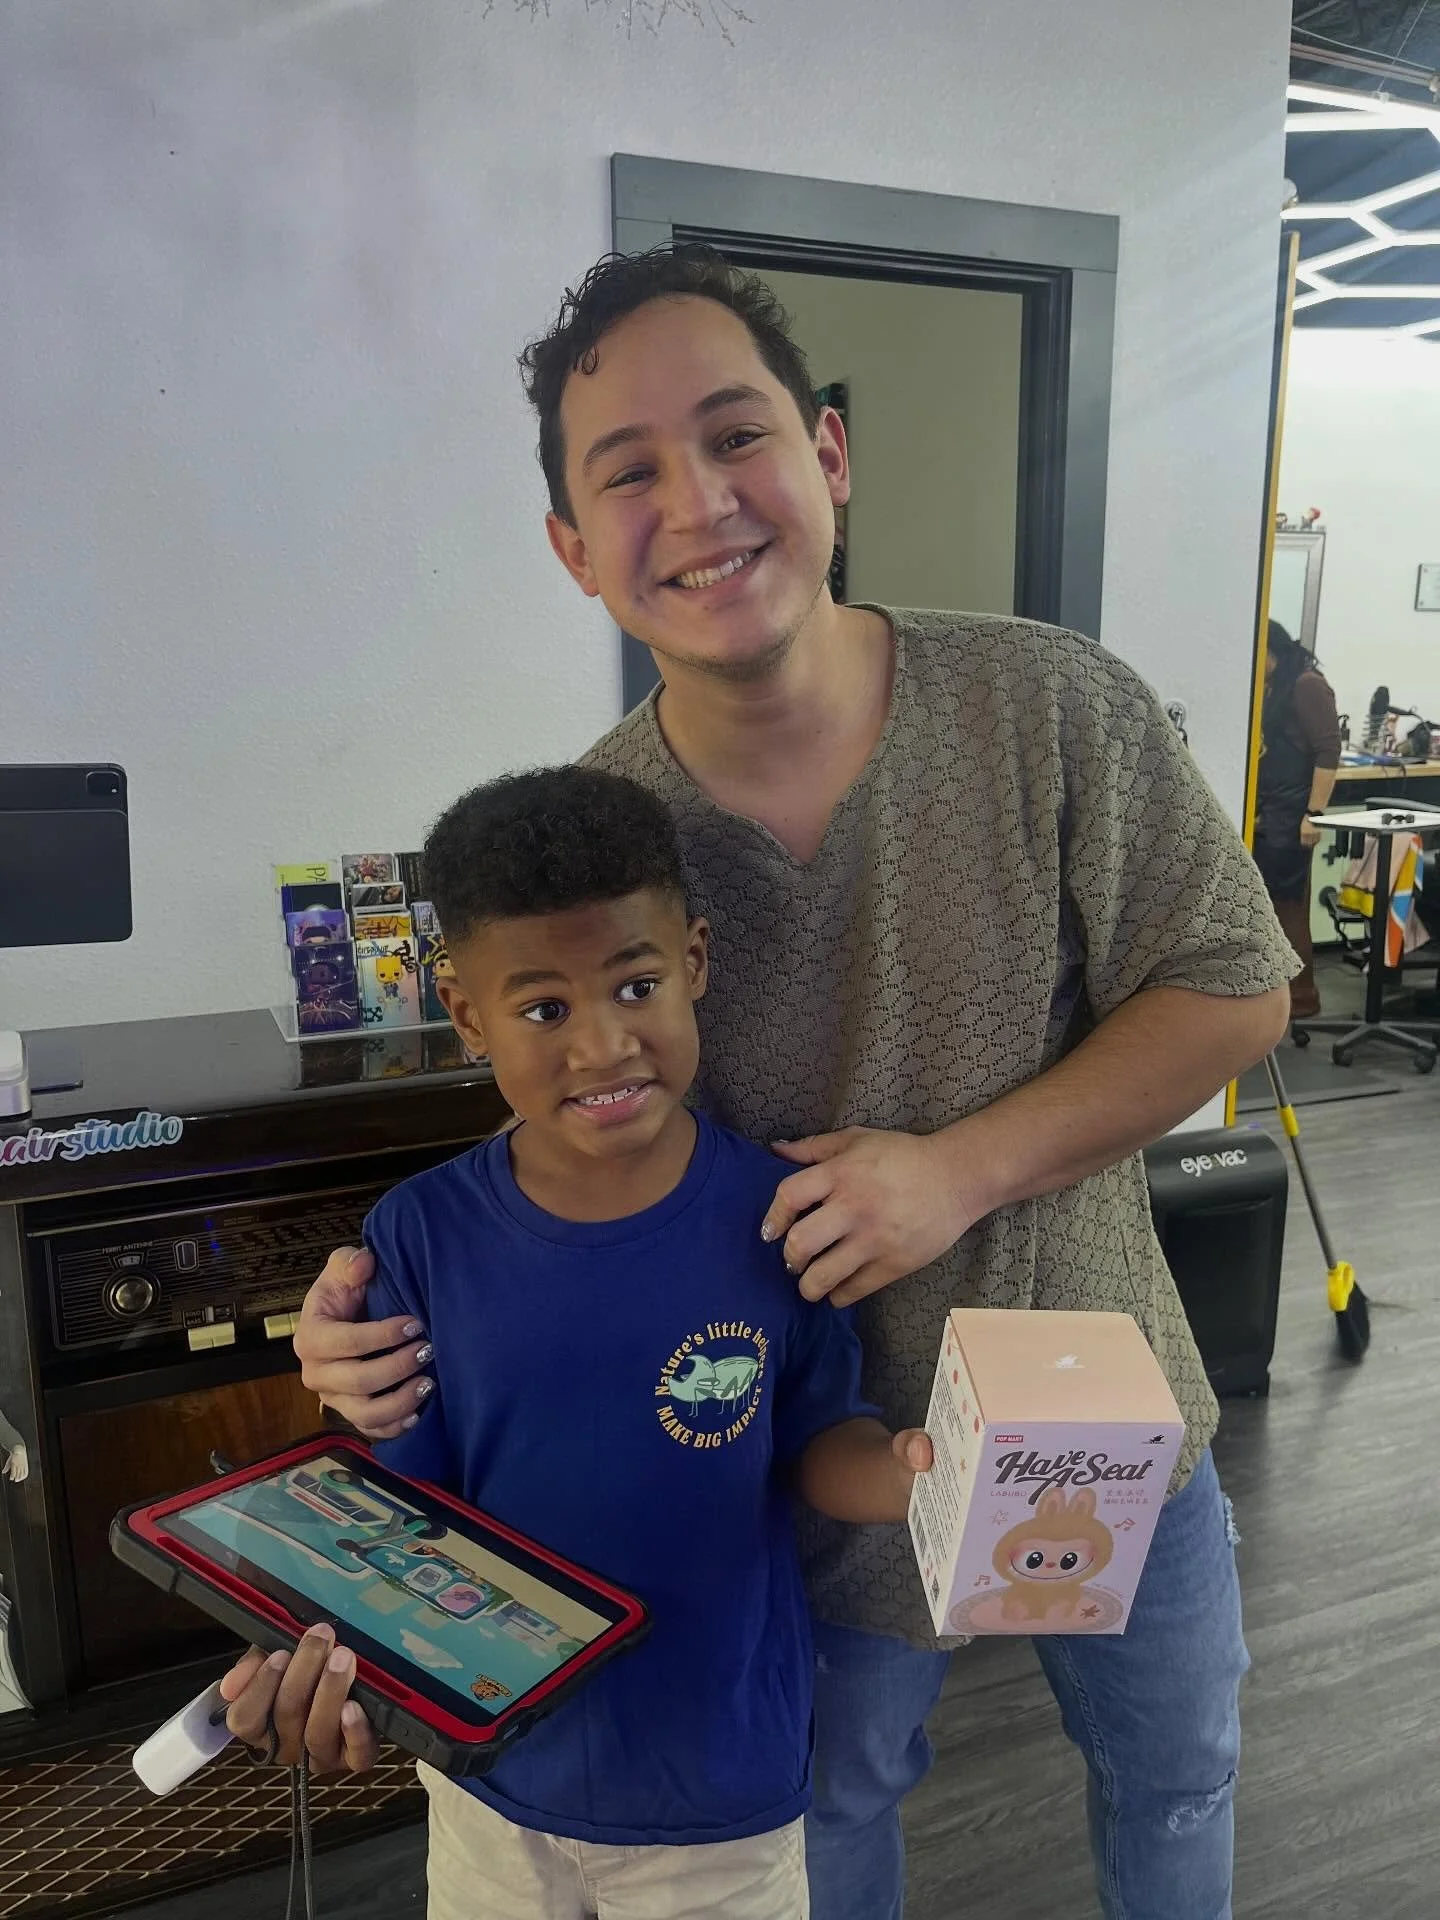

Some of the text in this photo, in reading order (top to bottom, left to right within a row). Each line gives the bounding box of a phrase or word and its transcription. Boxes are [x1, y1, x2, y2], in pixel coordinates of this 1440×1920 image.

[0, 1111, 183, 1166] air studio
[1180, 1148, 1248, 1177] eye vac
[655, 1332, 705, 1396] Nature's
[706, 1320, 752, 1340] little
[656, 1384, 763, 1448] MAKE BIG IMPACT
[994, 1450, 1154, 1506] Have A Seat
